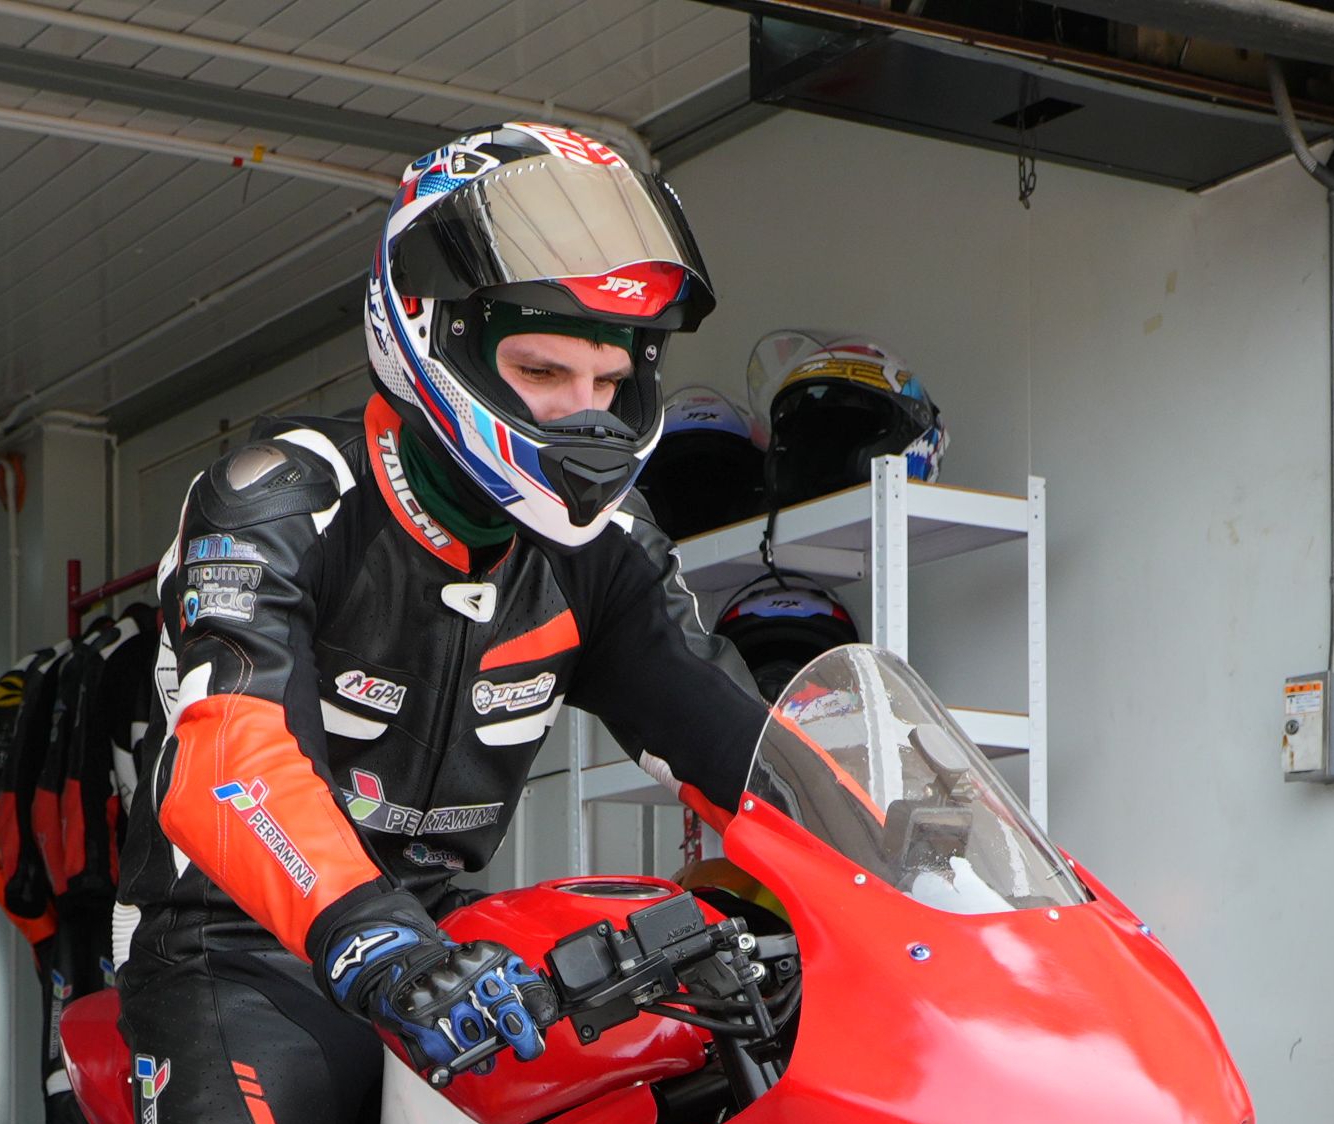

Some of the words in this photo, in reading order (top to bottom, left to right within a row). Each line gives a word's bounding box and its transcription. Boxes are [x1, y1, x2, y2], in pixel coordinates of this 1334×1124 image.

[597, 276, 648, 299] JPX
[378, 429, 451, 549] TAICHI
[386, 805, 501, 836] PERTAMINA
[248, 810, 315, 892] PERTAMINA
